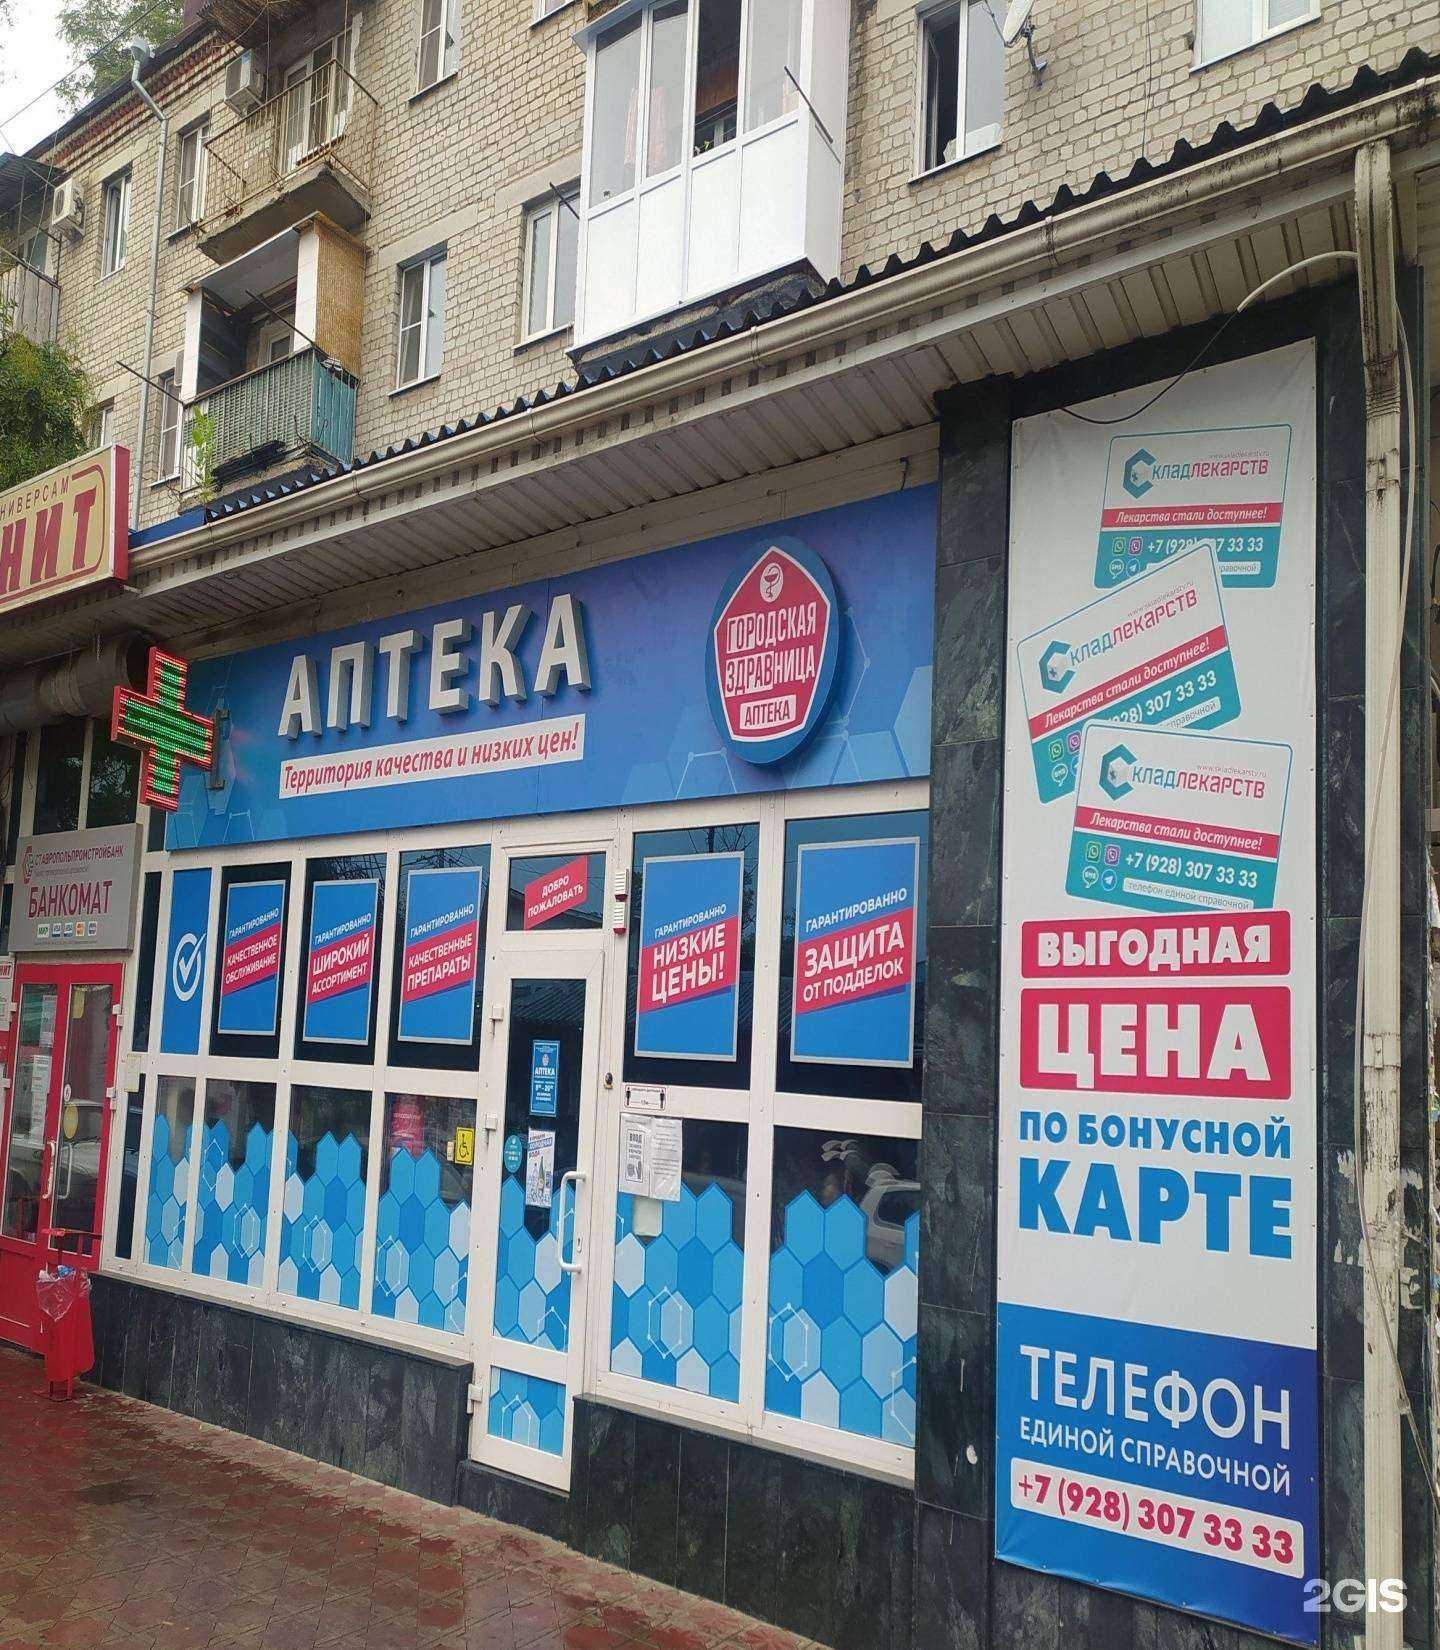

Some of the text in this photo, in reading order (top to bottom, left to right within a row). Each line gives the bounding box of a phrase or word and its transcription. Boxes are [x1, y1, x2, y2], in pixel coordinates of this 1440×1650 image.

[1115, 508, 1268, 524] Лекарства стали доступнее!
[0, 486, 97, 595] НИТ
[1148, 539, 1163, 553] +7
[1227, 538, 1243, 553] 33
[1247, 537, 1263, 552] 33
[727, 601, 816, 653] ГОРОДСКАЯ
[277, 593, 590, 739] АПТЕКА
[725, 645, 815, 696] ЗДРАВНИЦА
[1045, 637, 1210, 728] Лекарства стали доступнее!
[744, 699, 790, 727] АПТЕКА
[1145, 690, 1172, 716] 307
[1176, 681, 1195, 702] 33
[1198, 670, 1217, 692] 33
[284, 722, 580, 795] Территория качества и низких цен!
[1090, 812, 1262, 851] Лекарства стали доступнее!
[541, 875, 570, 898] ДОБРО
[1126, 852, 1258, 888] +7 (928) 307 33 33
[28, 880, 112, 918] БАНКОМАТ
[527, 884, 584, 919] ПОЖАЛОВАТЬ
[805, 888, 907, 933] ГАРАНТИРОВАННО
[1128, 882, 1250, 911] телефон единой справочной
[228, 907, 279, 937] ГАРАНТИРОВАННО
[315, 912, 371, 945] ГАРАНТИРОВАННО
[410, 903, 475, 939] ГАРАНТИРОВАННО
[654, 904, 727, 939] ГАРАНТИРОВАННО
[226, 934, 278, 965] КАЧЕСТВЕННОЕ
[312, 933, 370, 977] ШИРОКИЙ
[408, 933, 473, 968] КАЧЕСТВЕННЫЕ
[653, 923, 726, 969] НИЗКИЕ
[804, 921, 904, 978] ЗАЩИТА
[1037, 925, 1271, 972] ВЫГОДНАЯ
[225, 954, 277, 984] ОБСЛУЖИВАНИЕ
[311, 962, 368, 995] АССОРТИМЕНТ
[407, 953, 471, 992] ПРЕПАРАТЫ
[652, 951, 725, 1004] ЦЕНЫ!
[803, 957, 904, 1003] ОТ ПОДДЕЛОК
[1038, 1003, 1271, 1089] ЦЕНА
[534, 1067, 555, 1076] АПТЕКА
[1020, 1111, 1292, 1159] ПО БОНУСНОЙ
[1019, 1157, 1292, 1260] КАРТЕ
[1020, 1344, 1290, 1450] ТЕЛЕФОН
[1020, 1416, 1290, 1496] ЕДИНОЙ СПРАВОЧНОЙ
[1018, 1474, 1294, 1564] +7 (928) 307 33 33
